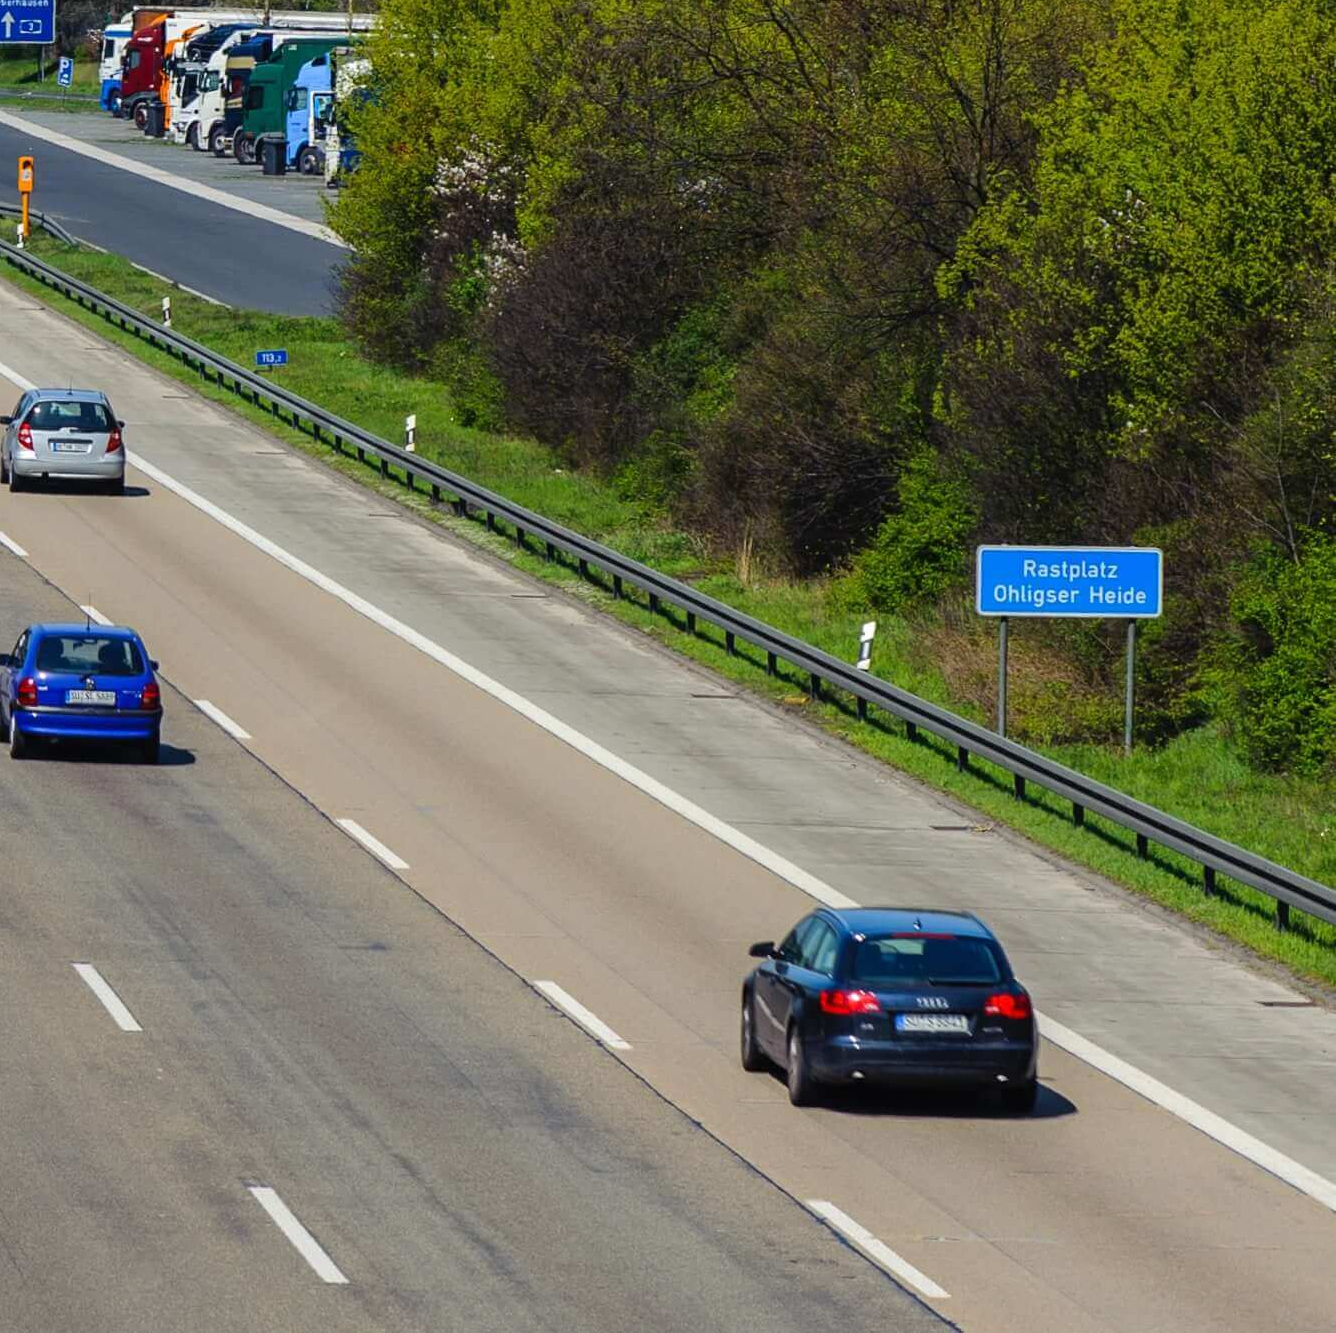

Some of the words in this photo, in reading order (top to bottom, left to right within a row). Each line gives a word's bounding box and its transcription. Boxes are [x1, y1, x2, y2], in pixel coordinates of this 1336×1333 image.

[1023, 559, 1118, 582] Rastplatz
[994, 584, 1079, 608] Ohligser
[1089, 586, 1147, 604] Heide
